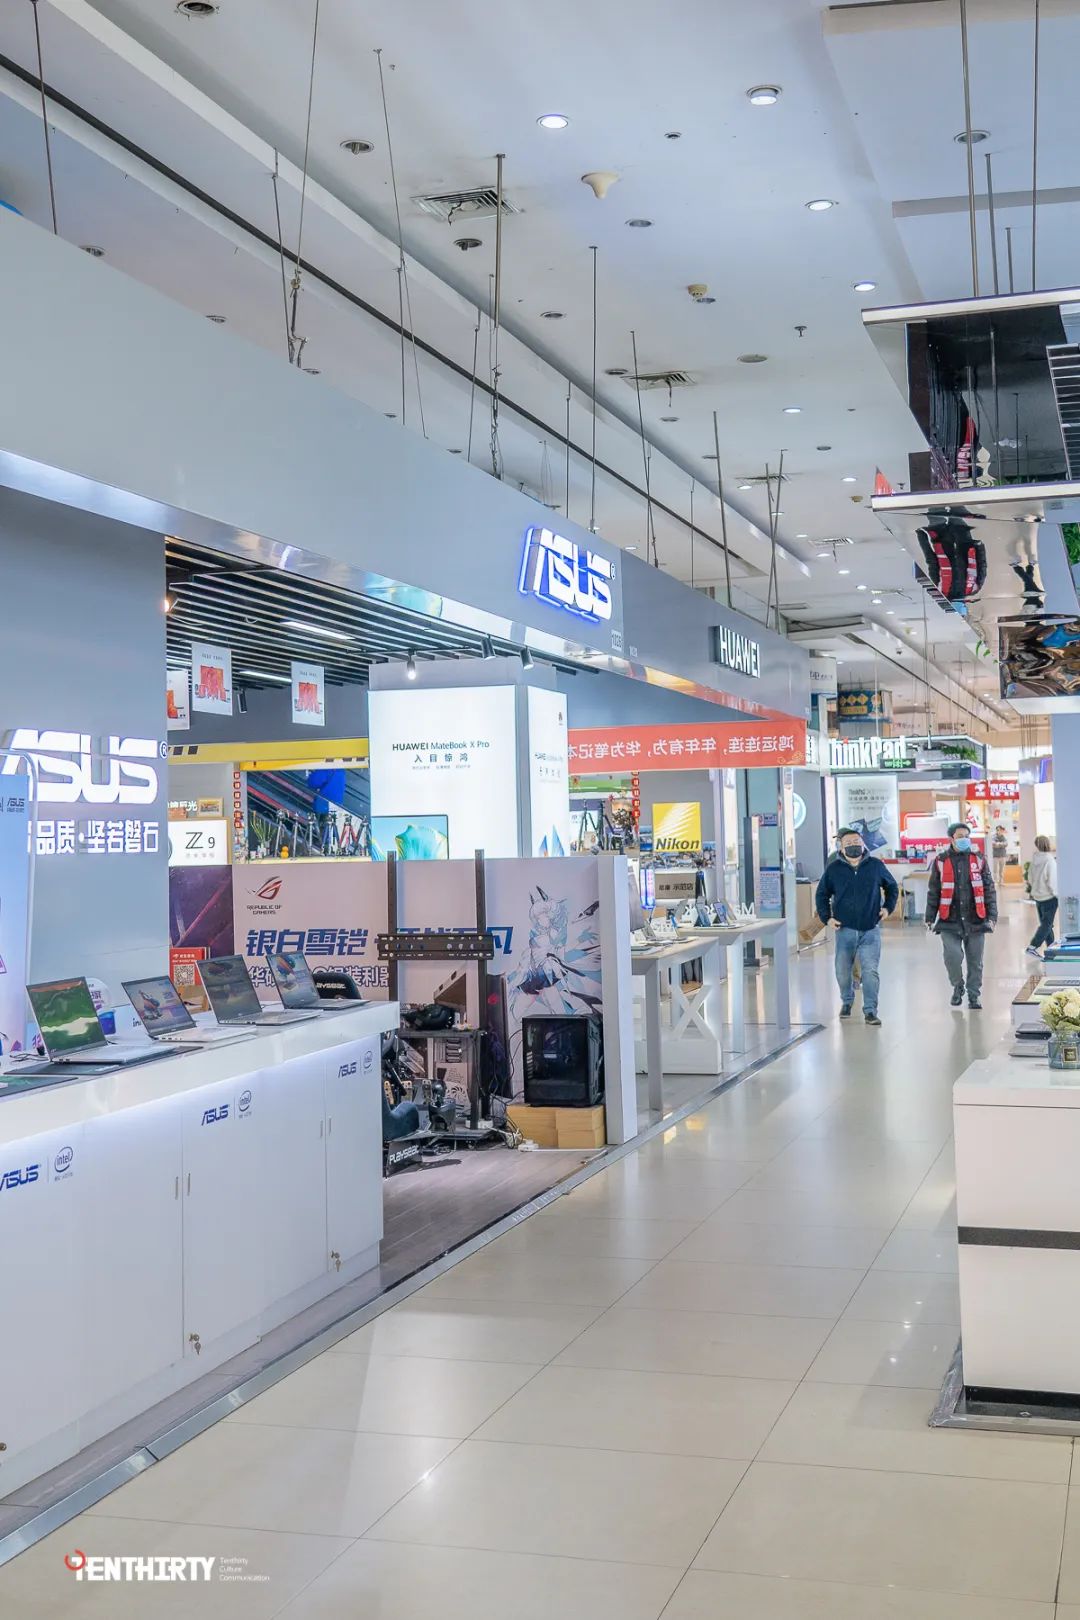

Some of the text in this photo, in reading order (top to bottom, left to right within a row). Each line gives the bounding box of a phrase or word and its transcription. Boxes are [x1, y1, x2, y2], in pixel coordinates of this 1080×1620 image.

[533, 528, 612, 620] ASUS
[719, 625, 761, 679] HUAWEI
[392, 743, 429, 751] HUAWEI
[431, 740, 467, 750] MateBook
[477, 740, 490, 748] Pro
[830, 735, 906, 769] hinkPad
[1, 729, 158, 804] ASUS
[208, 837, 215, 849] 9
[655, 838, 700, 851] Nikon
[246, 928, 369, 957] 银白雪铠
[338, 1061, 357, 1079] ASUS
[201, 1103, 230, 1126] ASUS
[0, 1163, 39, 1192] ASUS
